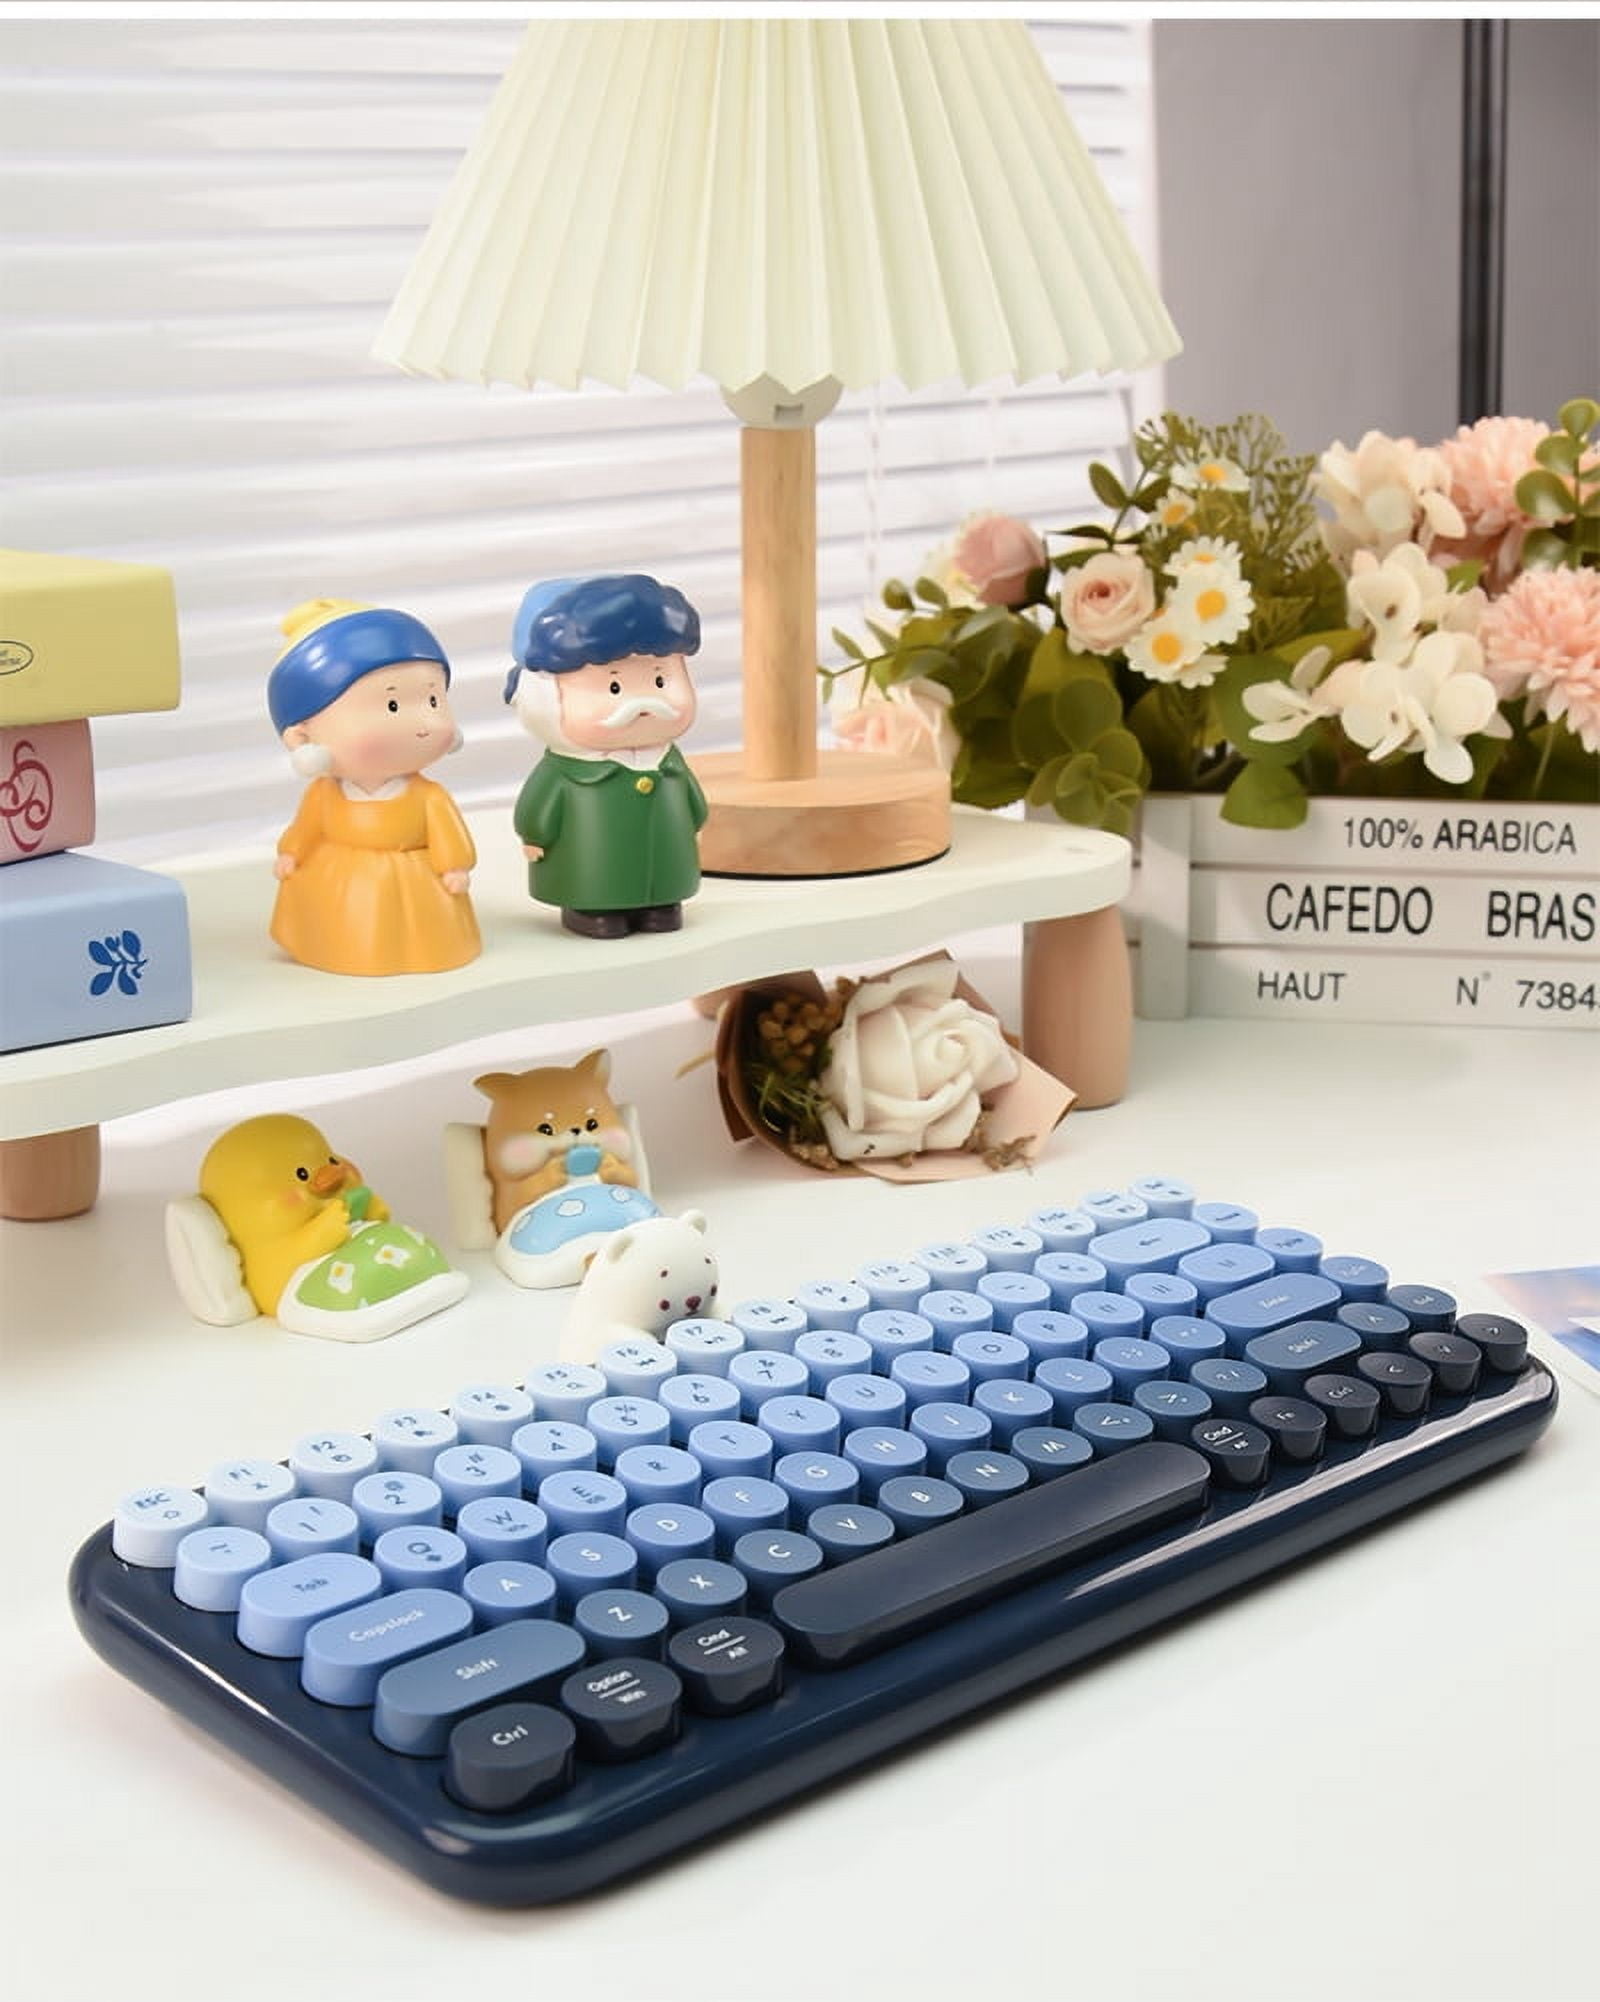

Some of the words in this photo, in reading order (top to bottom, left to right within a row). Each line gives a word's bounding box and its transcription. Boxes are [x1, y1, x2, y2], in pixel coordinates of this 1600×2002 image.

[1343, 817, 1423, 850] 100%
[1432, 819, 1578, 856] ARABICA
[1266, 882, 1434, 935] CAFEDO
[1486, 890, 1597, 943] BRAS
[1256, 970, 1347, 1002] HAUT
[1516, 979, 1600, 1012] 7384
[855, 1386, 877, 1398] U
[1001, 1391, 1025, 1404] K
[1202, 1425, 1234, 1442] Cmd
[550, 1441, 568, 1453] 4
[872, 1440, 897, 1455] H
[1040, 1439, 1068, 1454] M
[464, 1464, 487, 1478] 3
[646, 1460, 668, 1472] R
[804, 1464, 830, 1480] G
[974, 1462, 1001, 1478] N
[383, 1493, 407, 1506] 2
[734, 1490, 752, 1505] F
[910, 1489, 933, 1504] B
[485, 1509, 513, 1527] W
[655, 1519, 680, 1533] D
[836, 1517, 860, 1531] V
[579, 1548, 602, 1563] S
[767, 1543, 793, 1559] C
[499, 1577, 523, 1593] A
[687, 1574, 716, 1590] X
[606, 1605, 635, 1623] Z
[696, 1628, 732, 1648] Cmd
[454, 1657, 500, 1682] Shift
[585, 1669, 634, 1693] Option
[491, 1724, 530, 1746] Ctrl
